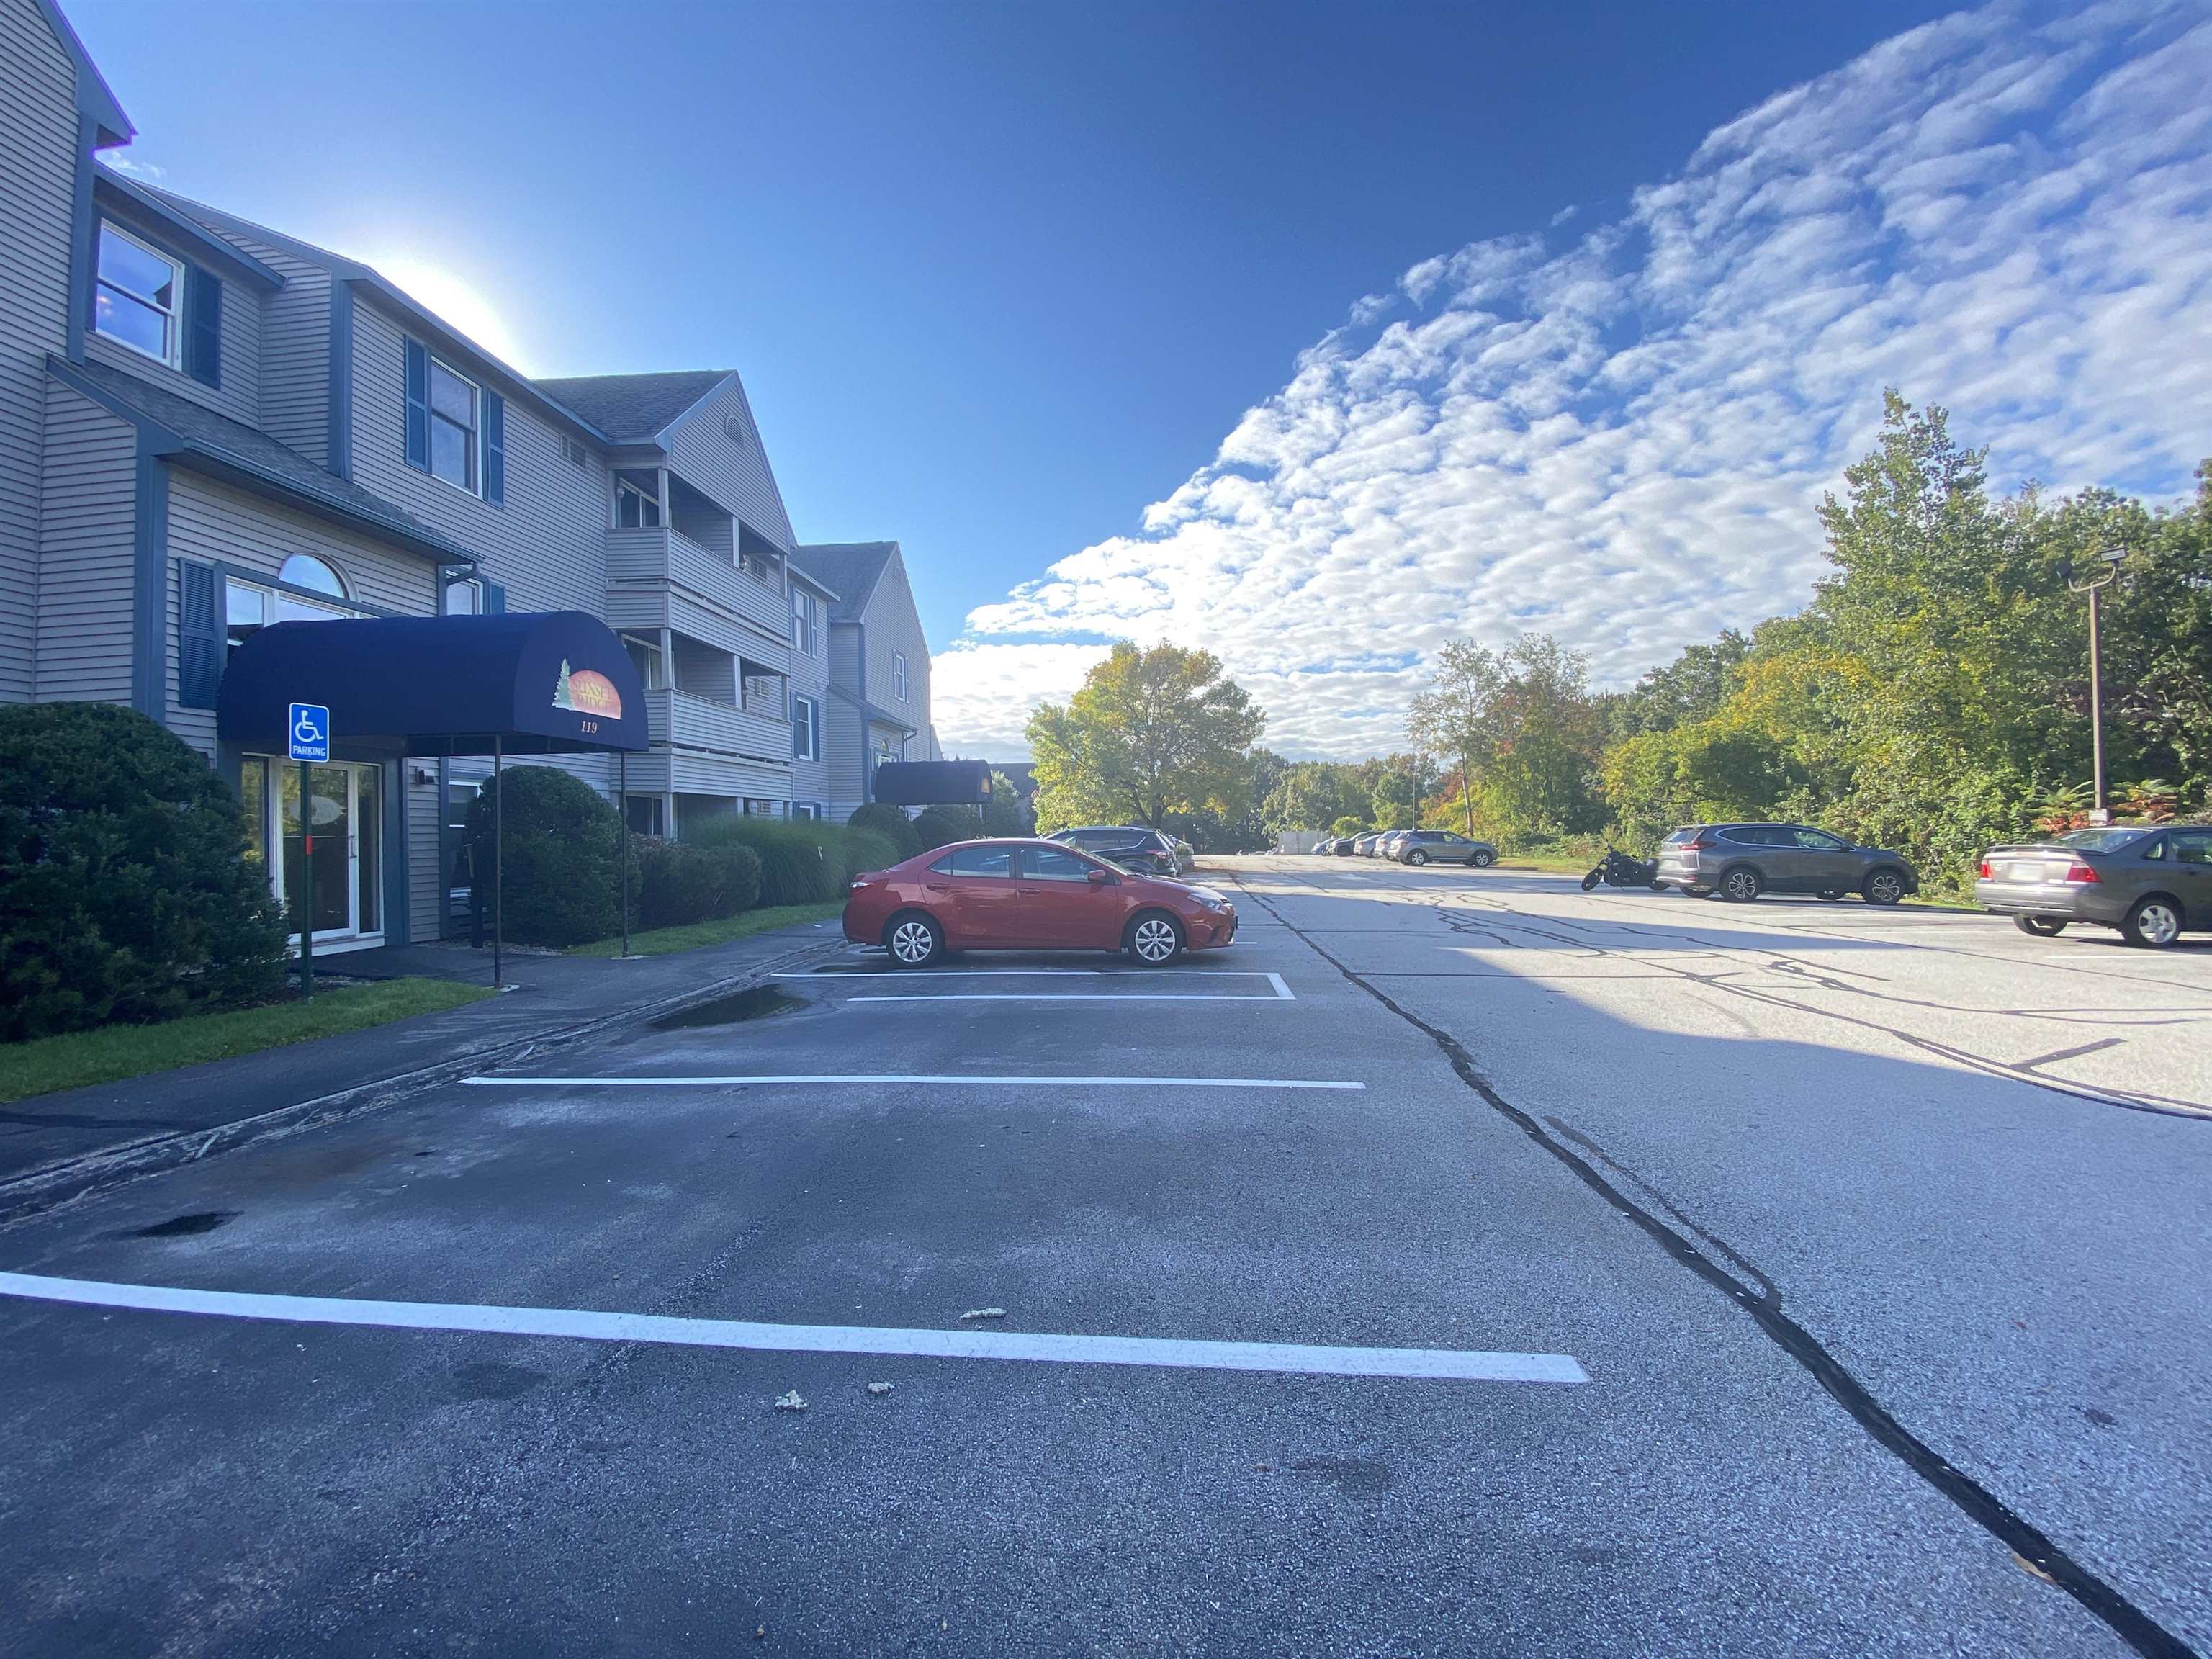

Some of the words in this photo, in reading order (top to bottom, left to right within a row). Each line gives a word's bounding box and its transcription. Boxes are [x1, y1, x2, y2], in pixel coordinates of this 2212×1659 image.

[573, 679, 612, 699] SUNSET
[581, 721, 598, 734] 119
[292, 745, 326, 757] PARKING
